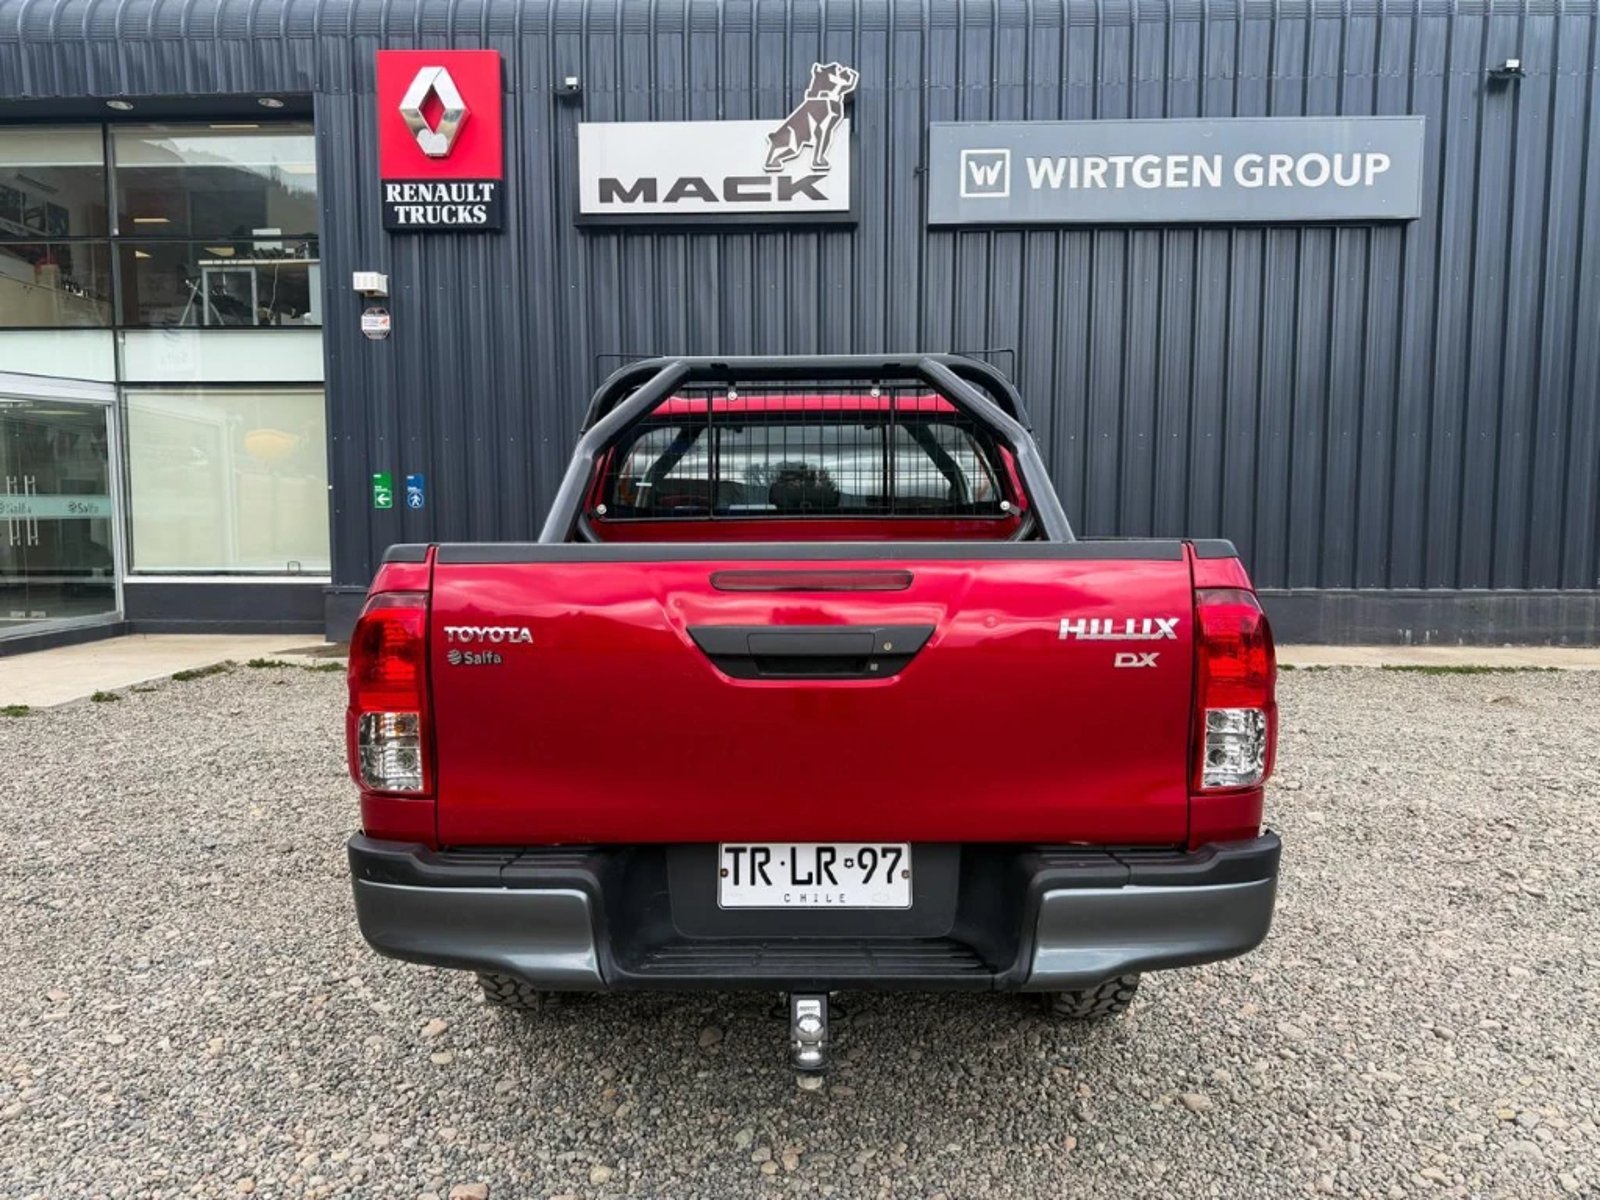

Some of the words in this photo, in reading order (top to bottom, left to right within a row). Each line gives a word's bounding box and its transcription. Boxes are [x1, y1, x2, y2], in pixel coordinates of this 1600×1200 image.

[1025, 154, 1222, 190] WIRTGEN
[1233, 152, 1391, 188] GROUP
[385, 183, 495, 202] RENAULT
[598, 174, 830, 203] MACK
[393, 204, 488, 224] TRUCKS
[443, 625, 534, 643] TOYOTA
[1058, 618, 1180, 640] HILUX
[463, 650, 503, 665] Salfa
[1114, 652, 1161, 668] DX
[783, 893, 847, 904] CHILE
